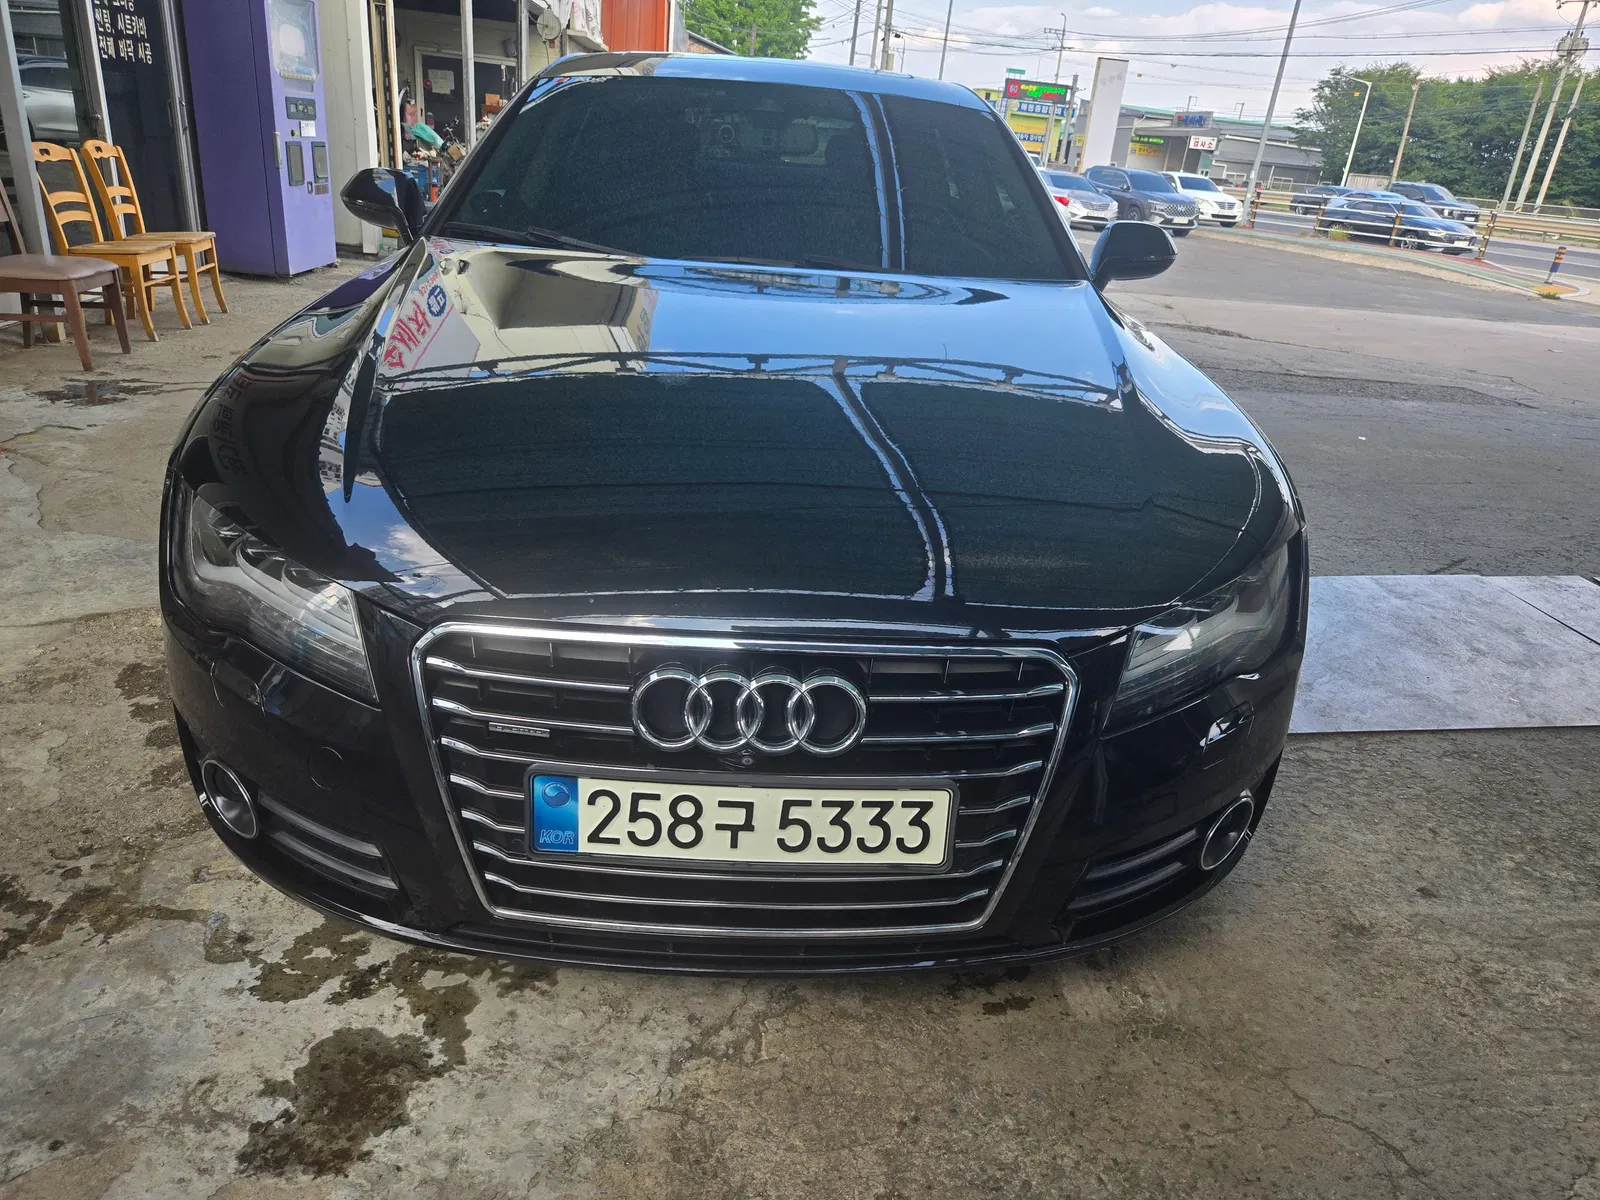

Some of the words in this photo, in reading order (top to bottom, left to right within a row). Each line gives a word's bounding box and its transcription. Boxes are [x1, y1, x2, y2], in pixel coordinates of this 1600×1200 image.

[98, 35, 116, 59] 전체
[118, 38, 136, 62] 바닥
[138, 41, 153, 65] 시공
[586, 788, 755, 850] 258구
[776, 799, 934, 854] 5333
[540, 829, 575, 845] KOR
